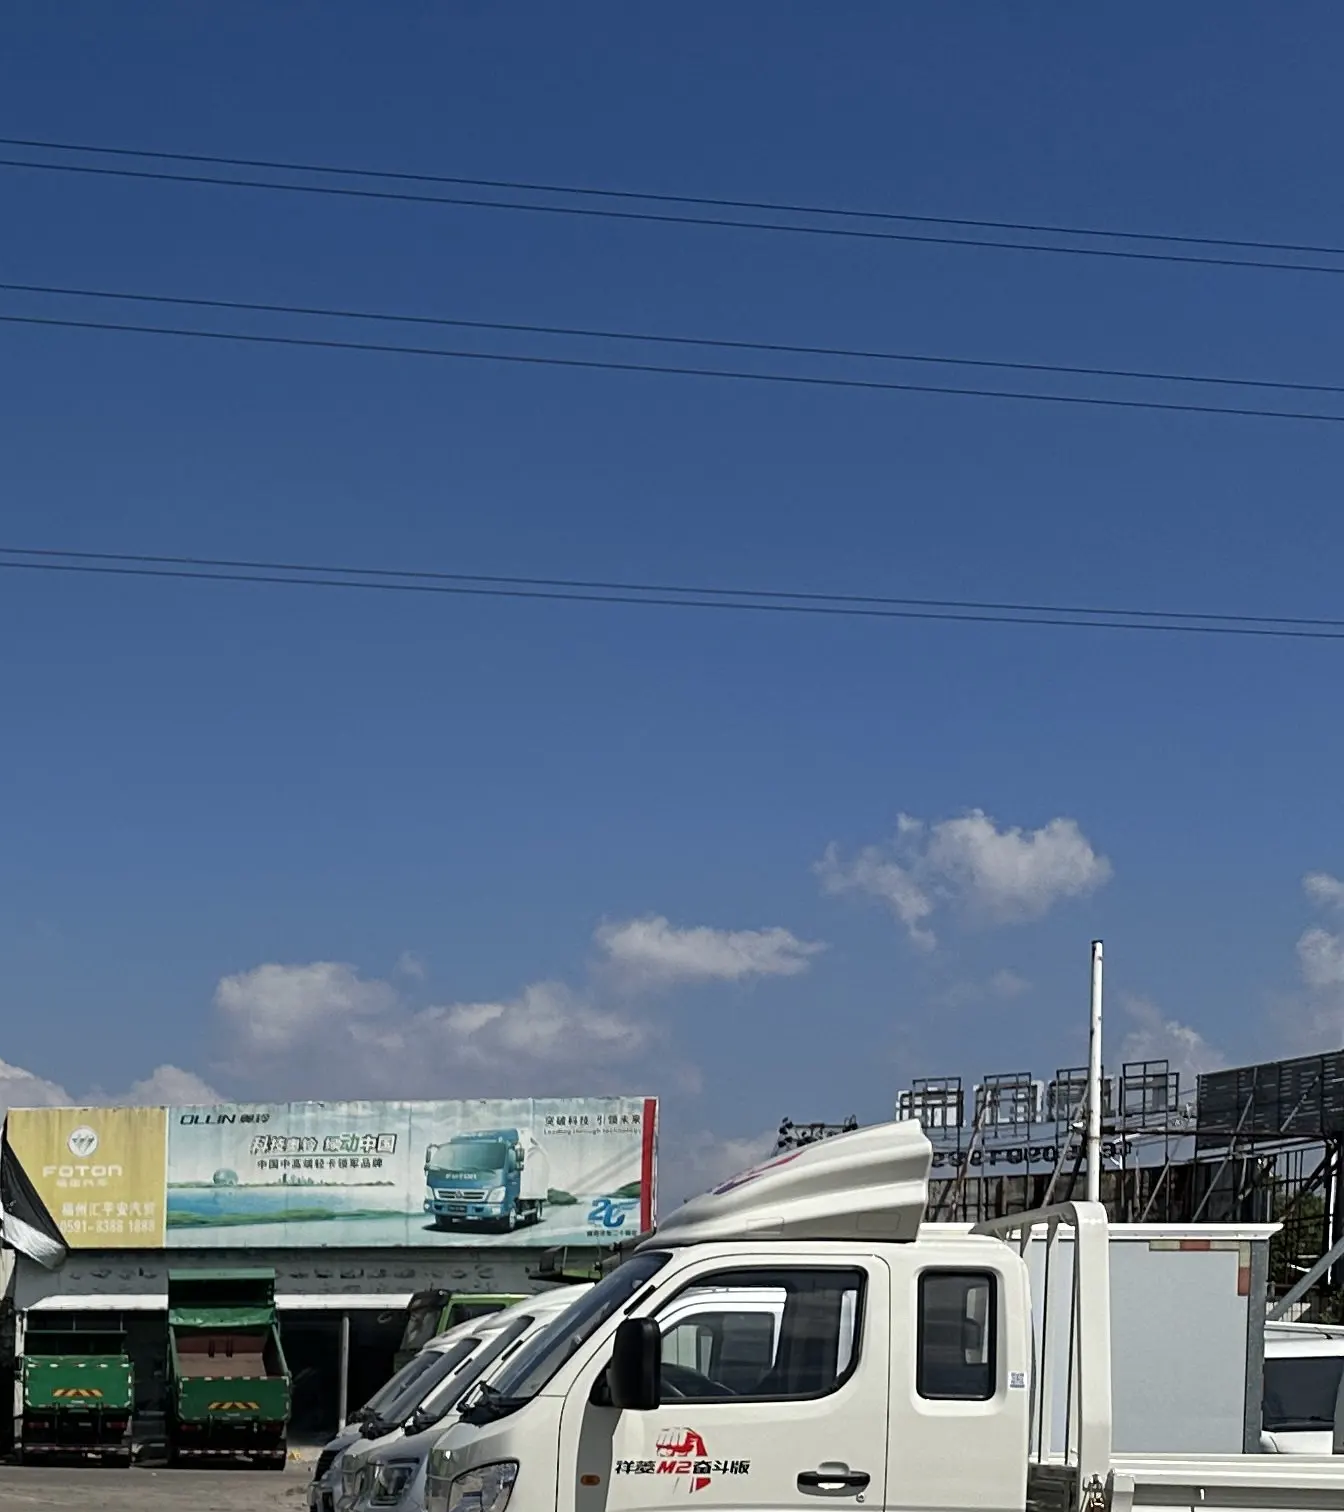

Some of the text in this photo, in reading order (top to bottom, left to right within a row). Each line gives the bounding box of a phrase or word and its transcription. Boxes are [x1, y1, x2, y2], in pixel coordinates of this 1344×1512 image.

[180, 1113, 236, 1125] OLLIN
[42, 1164, 123, 1178] FOTON
[615, 1459, 751, 1475] 祥菱M2奋斗版
